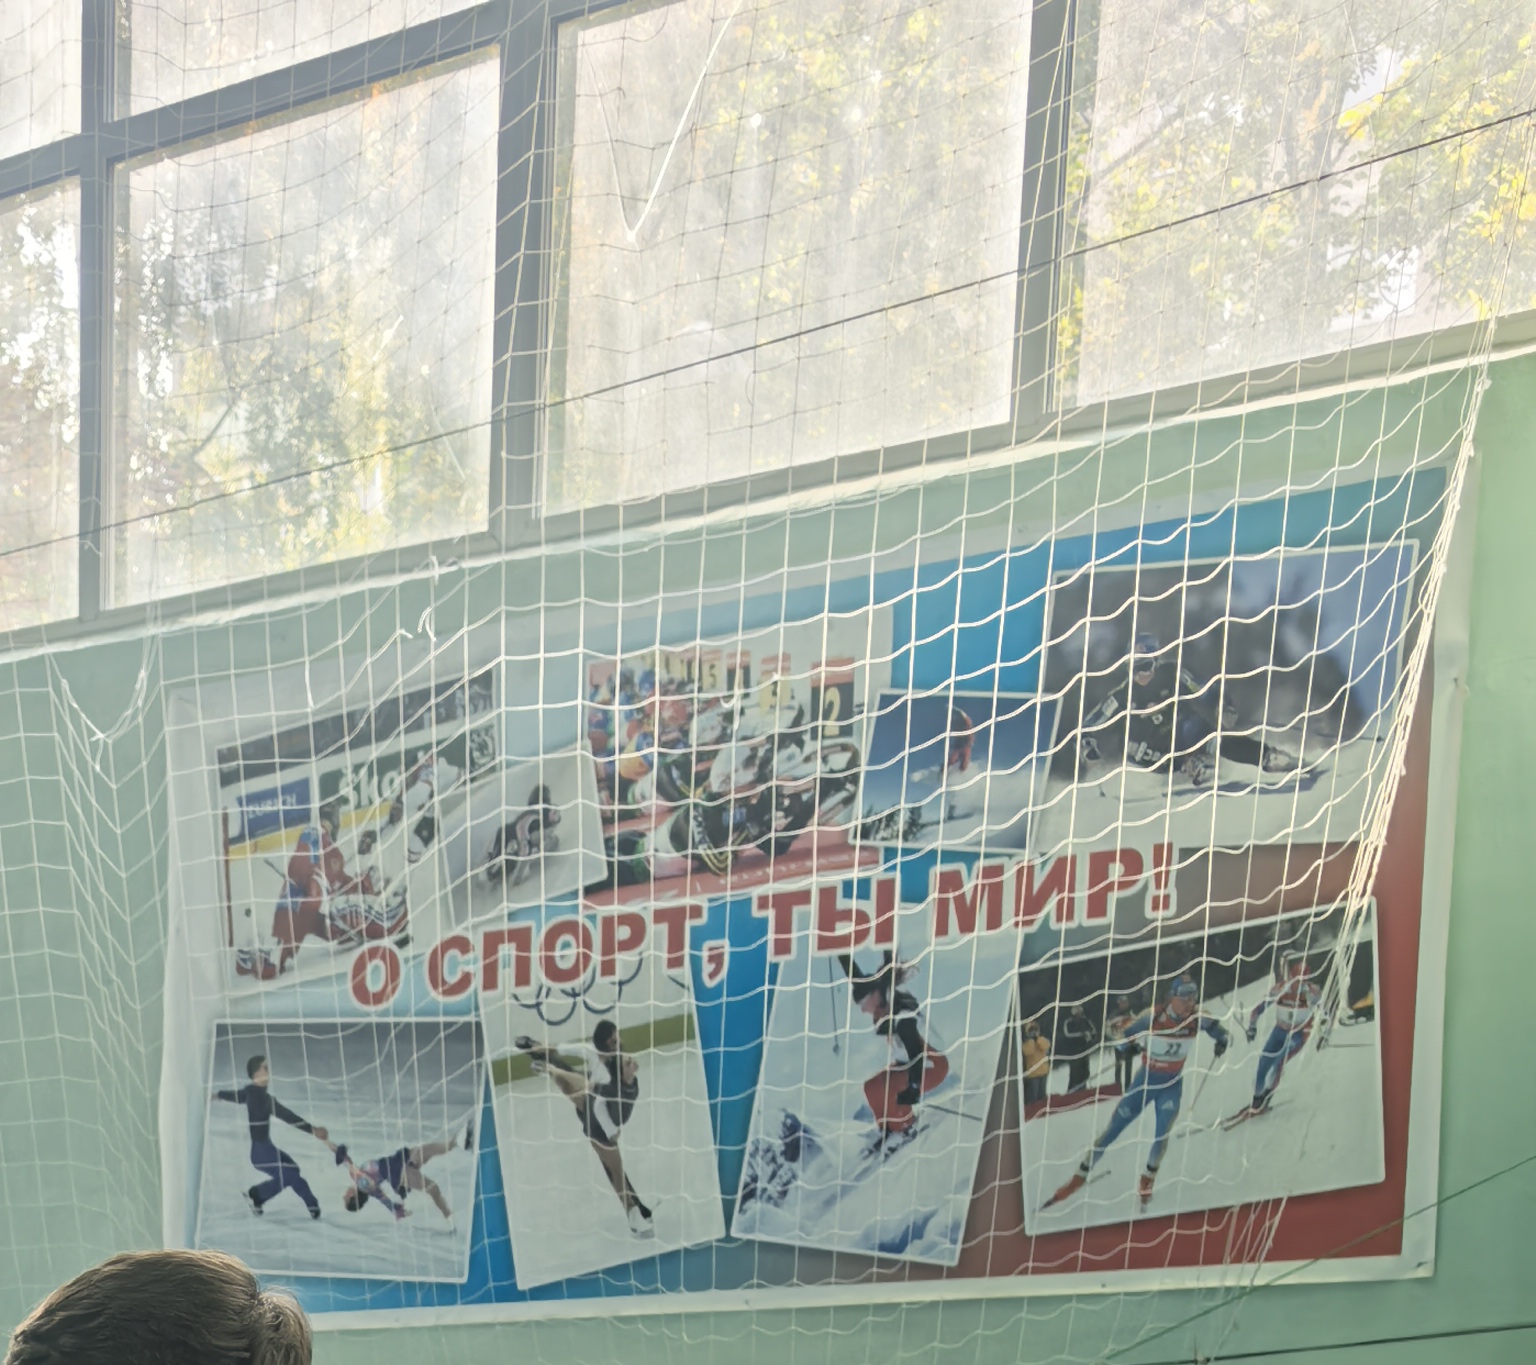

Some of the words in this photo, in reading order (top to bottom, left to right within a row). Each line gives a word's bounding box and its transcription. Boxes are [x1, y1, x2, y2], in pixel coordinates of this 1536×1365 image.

[824, 686, 841, 737] 2
[350, 944, 402, 1008] О
[427, 905, 726, 998] СПОРТ,
[756, 878, 896, 957] ТЫ
[934, 842, 1174, 938] МИР!
